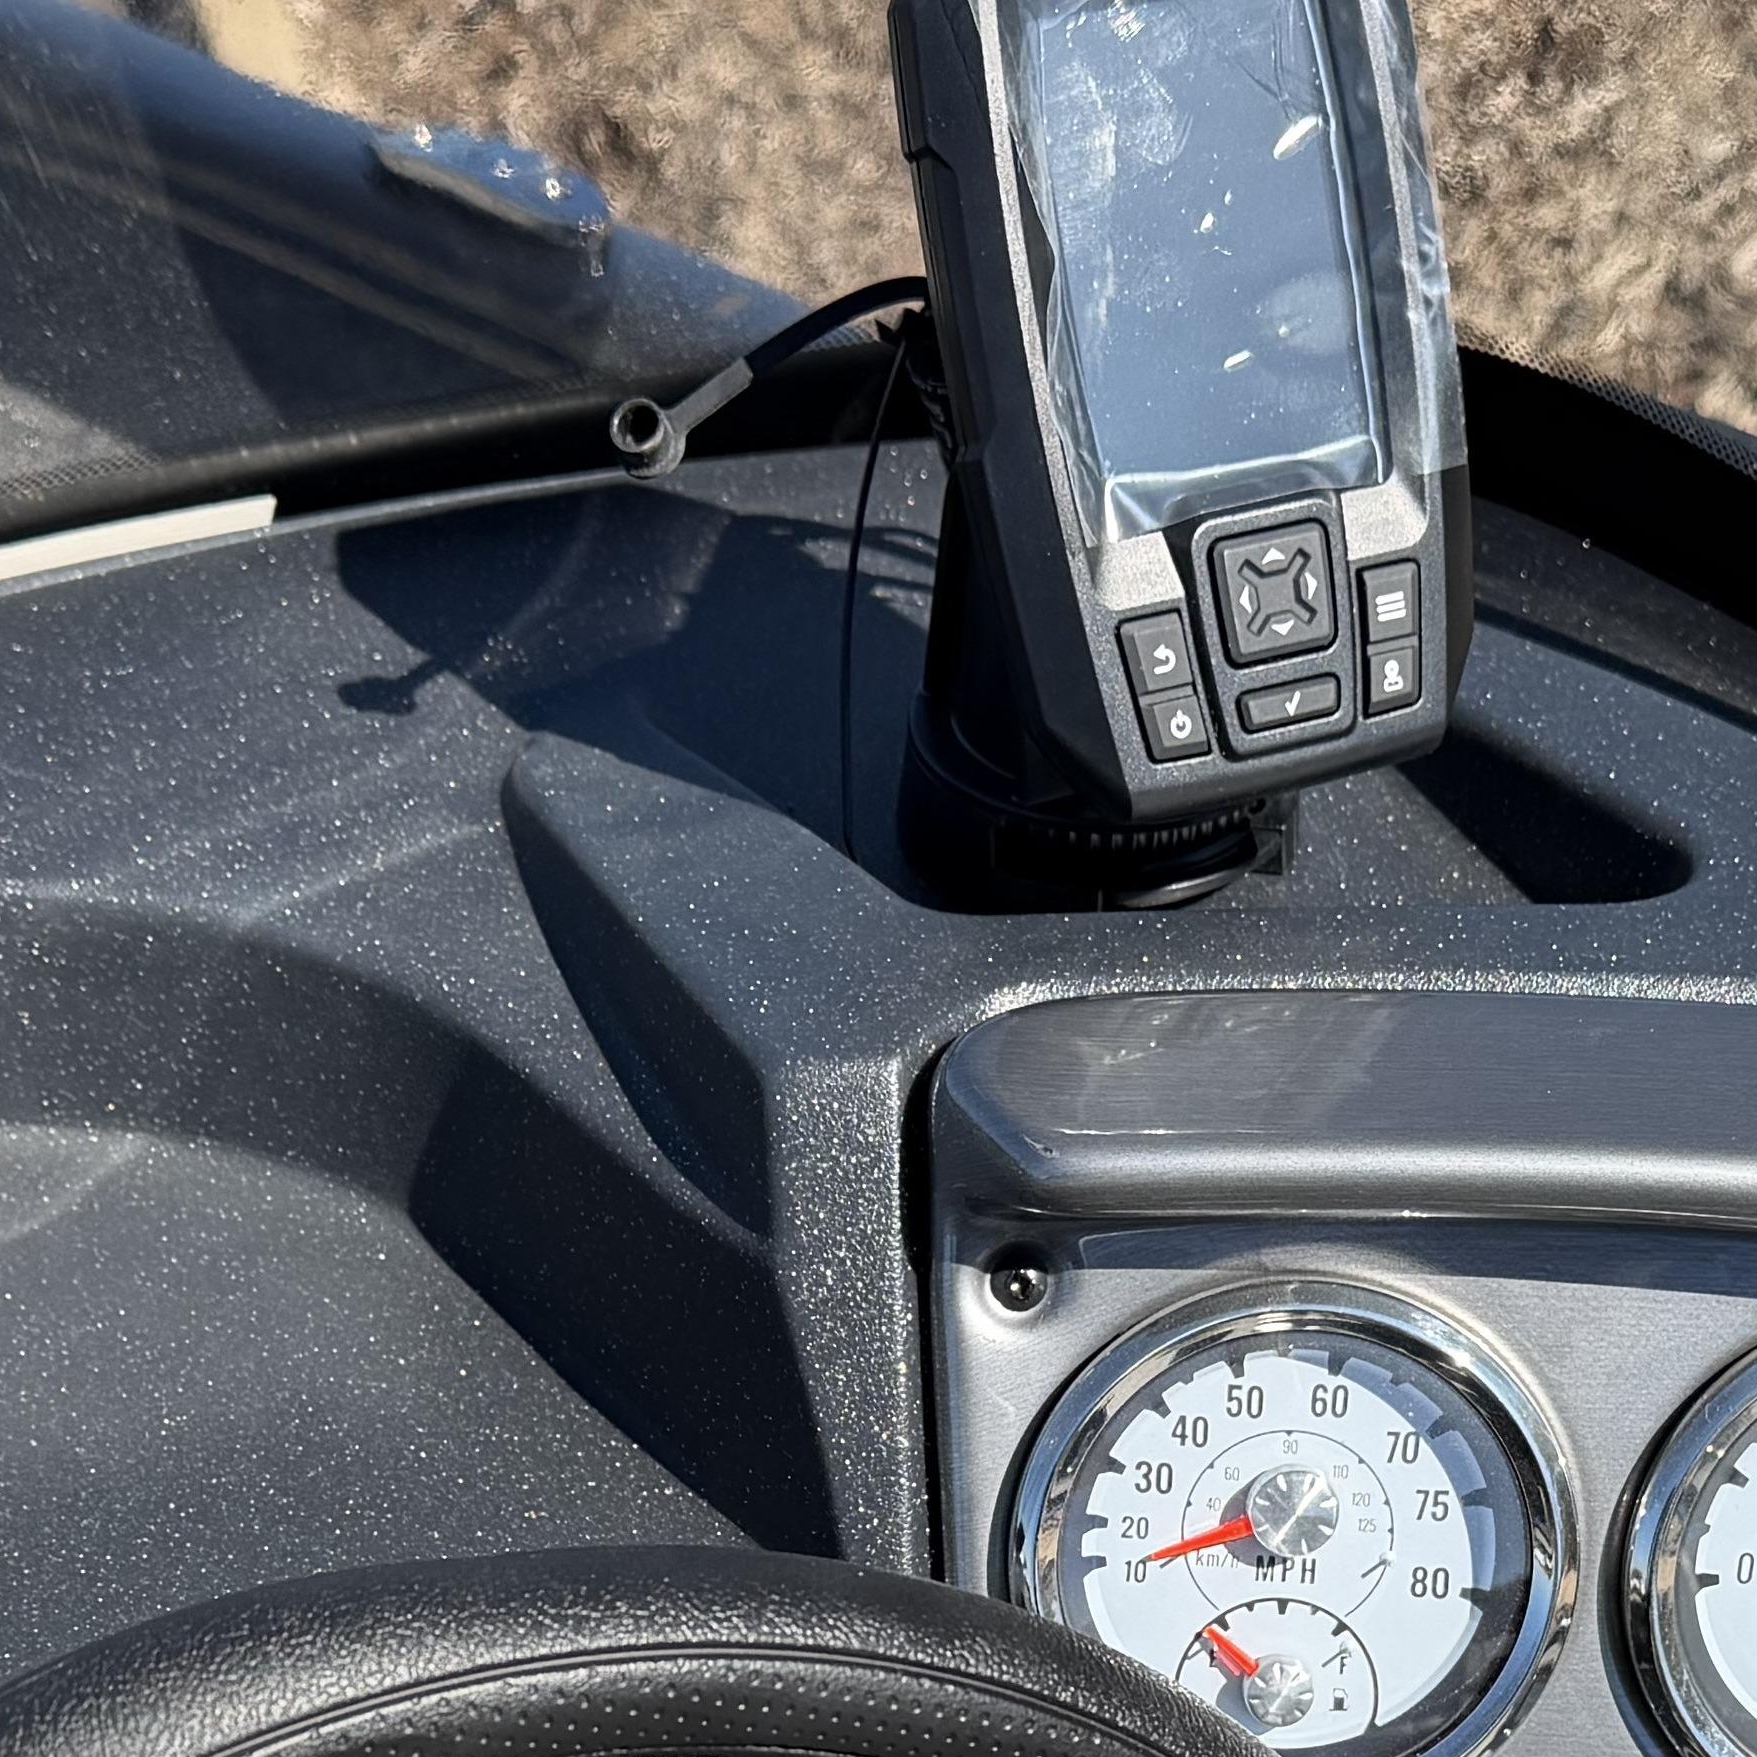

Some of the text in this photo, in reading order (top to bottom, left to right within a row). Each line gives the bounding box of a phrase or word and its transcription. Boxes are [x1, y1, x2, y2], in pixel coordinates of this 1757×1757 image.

[1226, 1384, 1264, 1419] 50
[1311, 1384, 1348, 1417] 60
[1171, 1415, 1208, 1447] 40
[1283, 1440, 1298, 1454] 90
[1387, 1431, 1420, 1464] 70
[1134, 1461, 1173, 1494] 30
[1225, 1467, 1239, 1480] 60
[1333, 1465, 1348, 1479] 110
[1206, 1498, 1221, 1511] 40
[1352, 1493, 1370, 1507] 120
[1416, 1490, 1449, 1521] 75
[1121, 1516, 1149, 1539] 20
[1358, 1519, 1376, 1533] 125
[1125, 1560, 1146, 1583] 10
[1255, 1555, 1316, 1584] MPH
[1411, 1567, 1449, 1599] 80
[1737, 1553, 1754, 1584] 0
